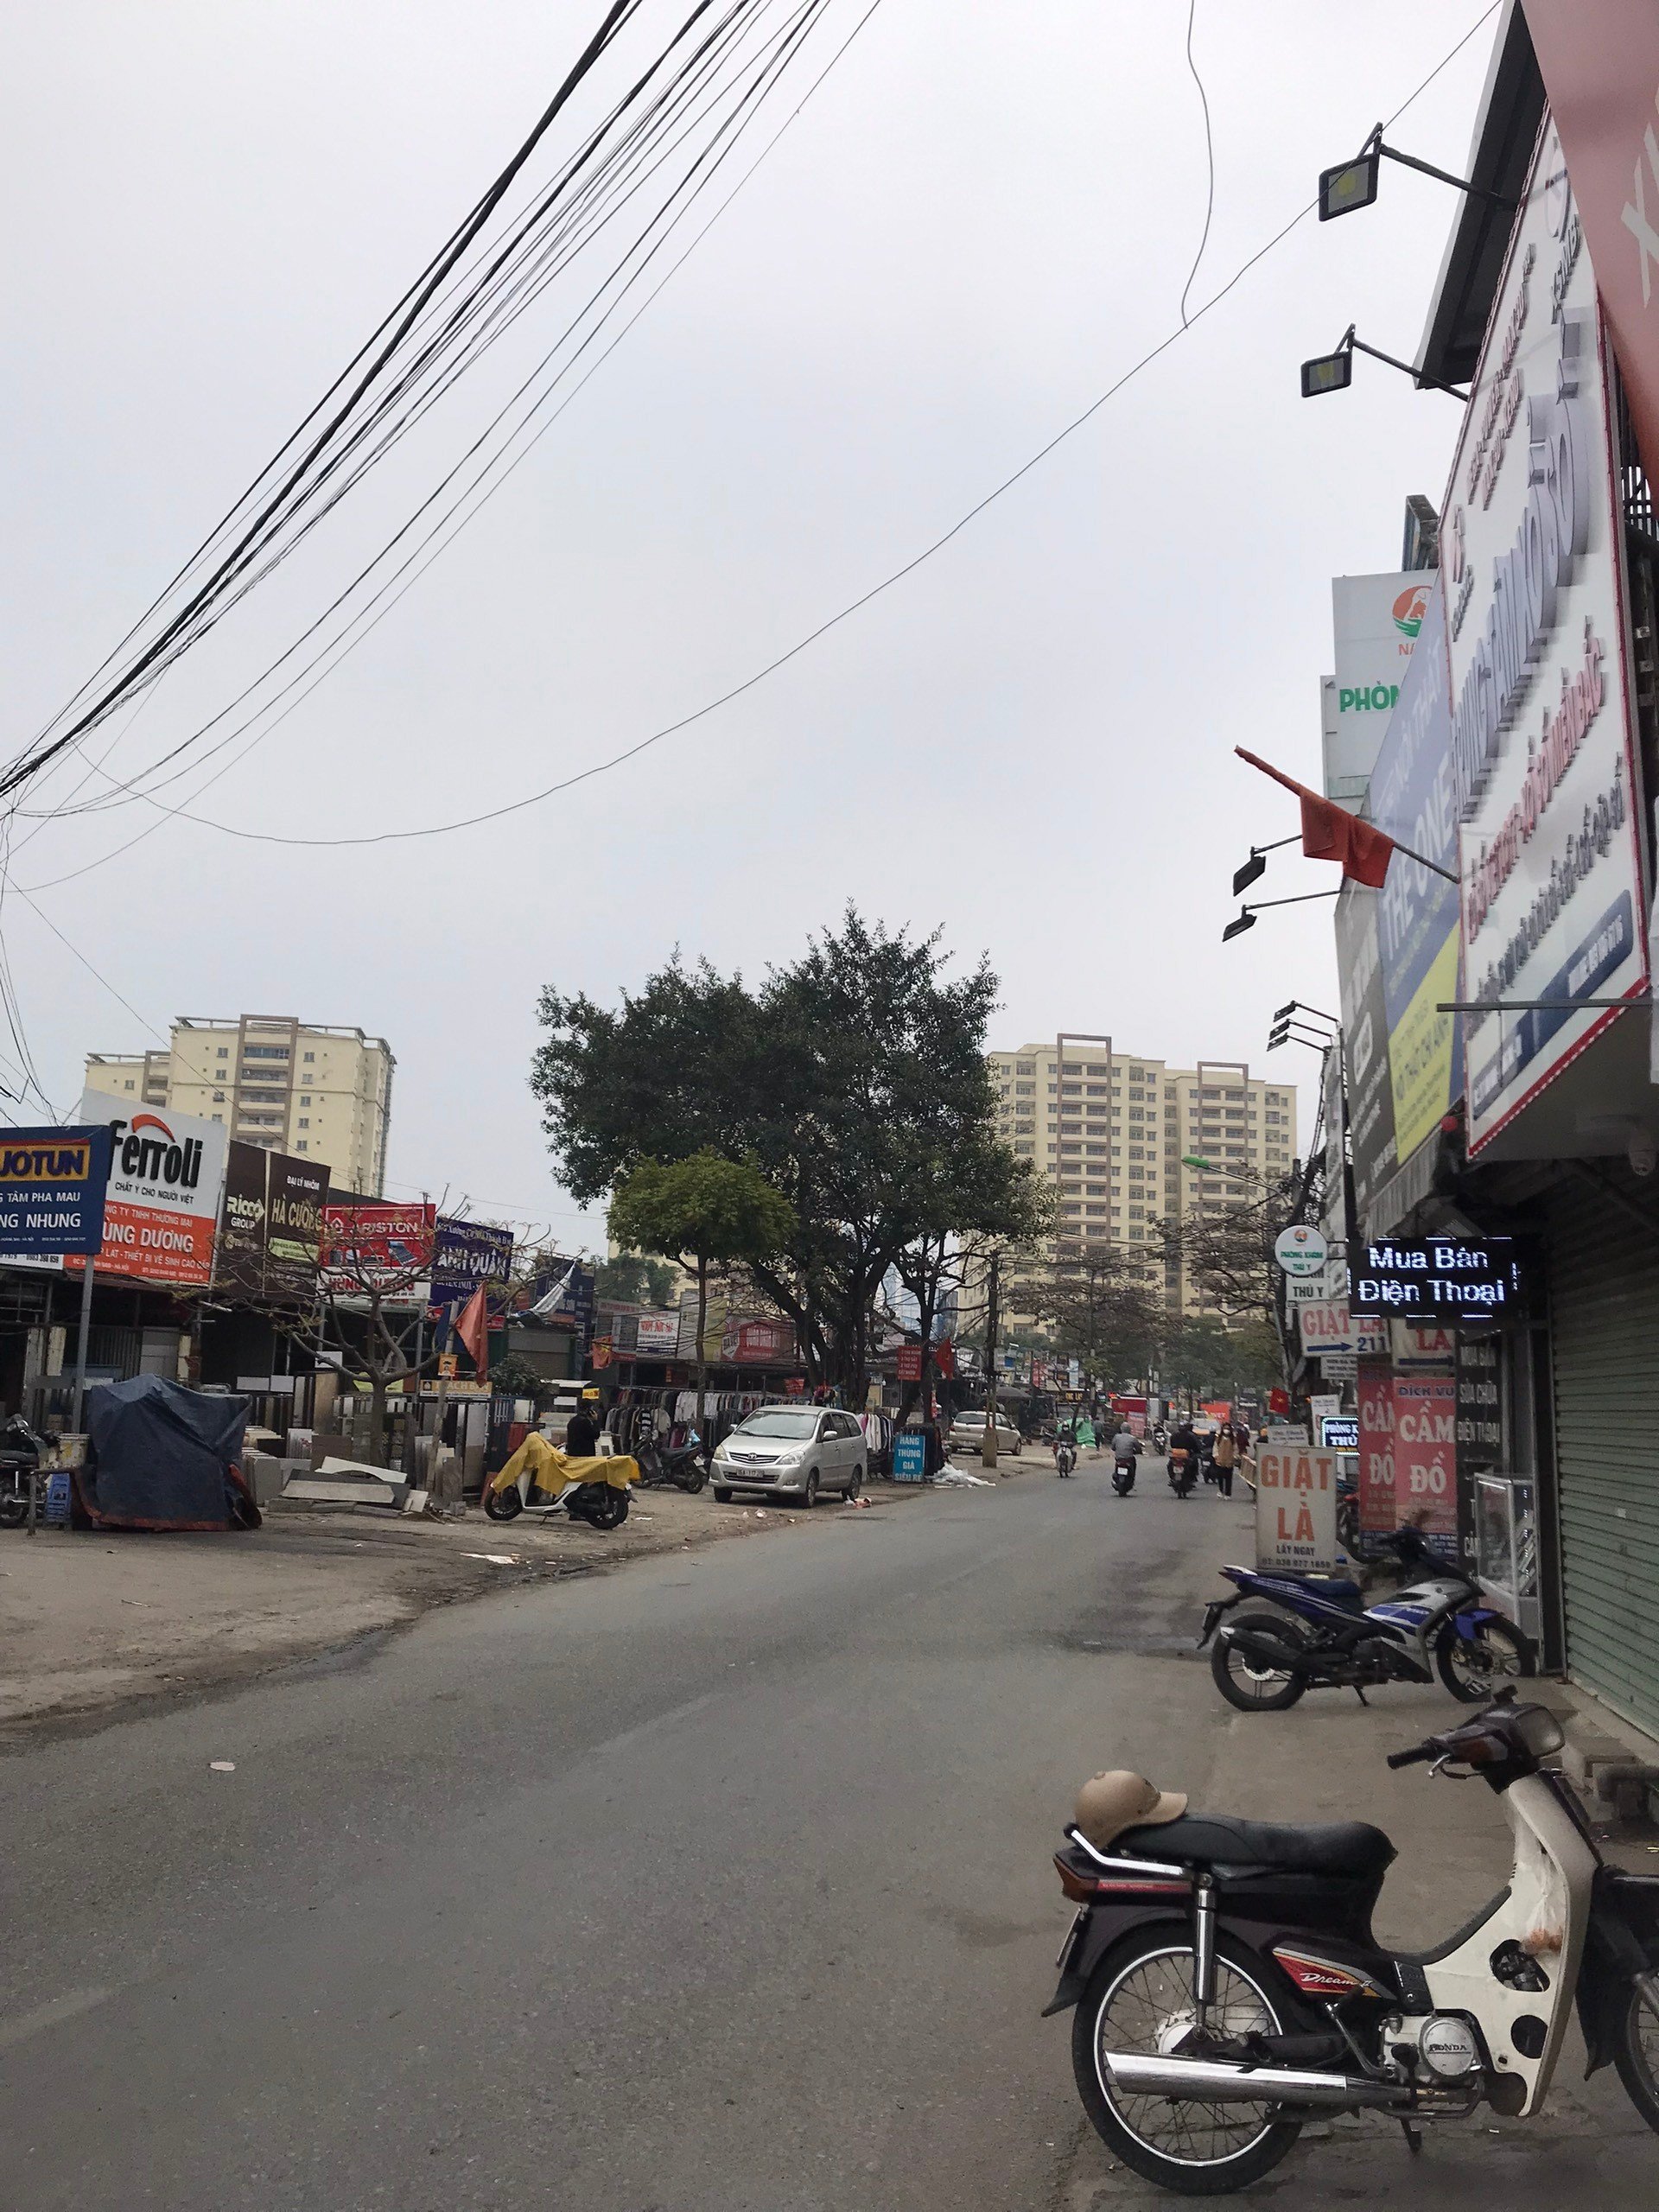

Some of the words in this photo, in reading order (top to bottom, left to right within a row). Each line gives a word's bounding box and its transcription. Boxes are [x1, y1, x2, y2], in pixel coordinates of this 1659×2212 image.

[0, 1150, 84, 1176] JOTUN
[32, 1192, 53, 1202] PHA
[142, 1187, 156, 1198] CHO
[119, 1206, 130, 1217] TY
[26, 1213, 81, 1228] NHUNG
[231, 1217, 256, 1230] GROUP
[1369, 1246, 1428, 1268] Mua
[1434, 1246, 1488, 1268] Bán
[1317, 1286, 1324, 1298] Y
[1358, 1280, 1421, 1306] Điện
[1426, 1280, 1505, 1306] Thoại
[1303, 1302, 1350, 1341] GIẶT
[1261, 1448, 1332, 1497] GIẶT
[1410, 1452, 1447, 1494] ĐỒ
[1278, 1501, 1315, 1541] LÀ
[1294, 1546, 1315, 1557] NGAY
[1300, 1972, 1357, 1986] Dream
[1428, 2043, 1467, 2051] HONDA
